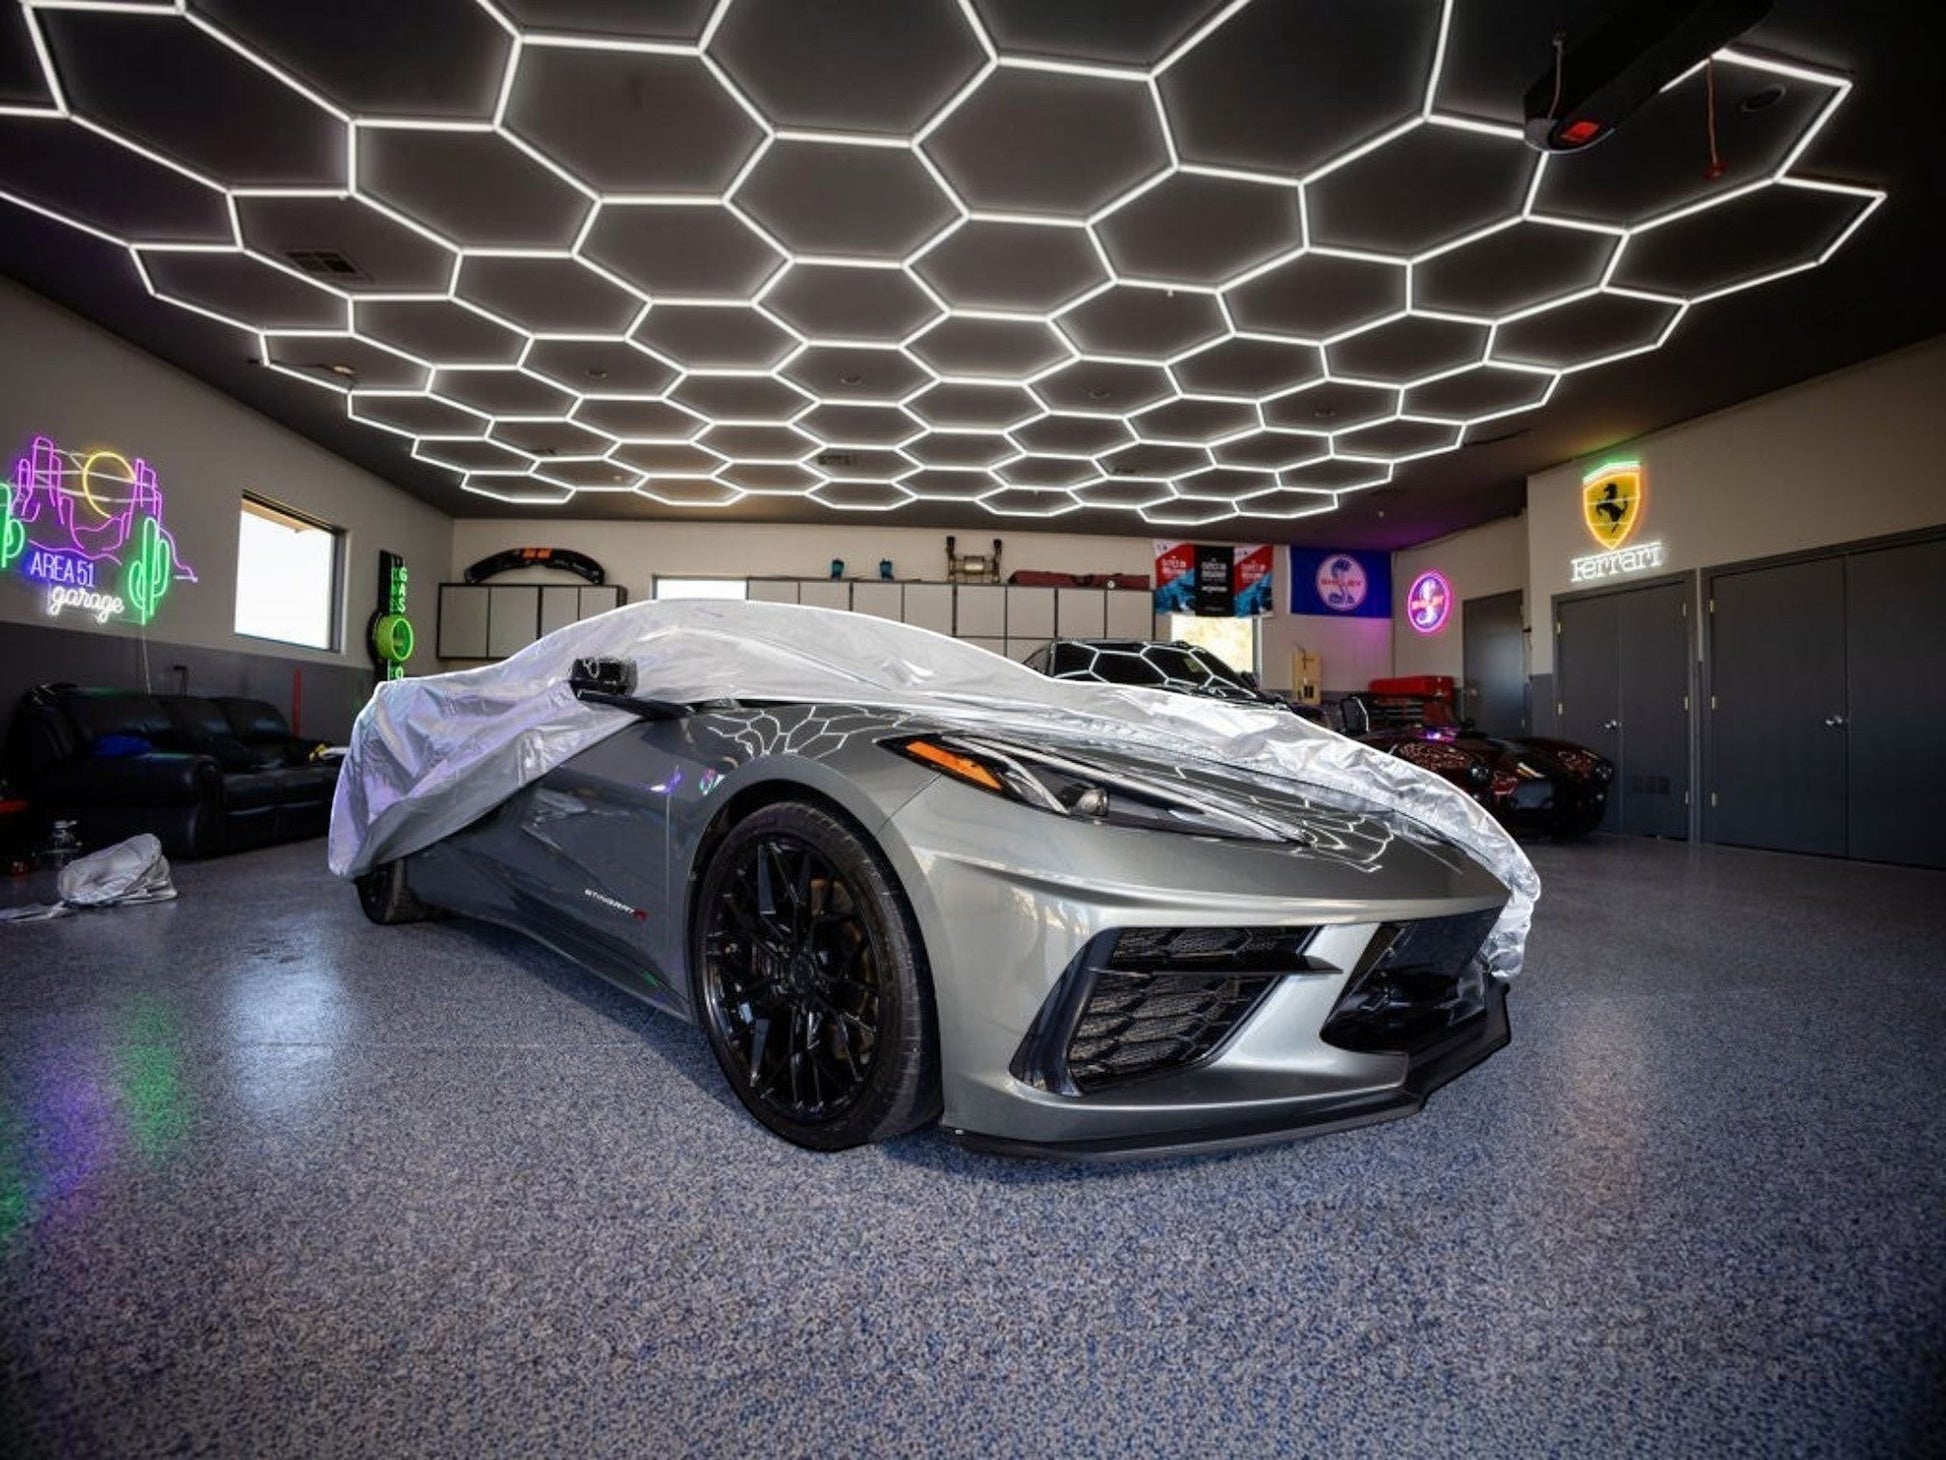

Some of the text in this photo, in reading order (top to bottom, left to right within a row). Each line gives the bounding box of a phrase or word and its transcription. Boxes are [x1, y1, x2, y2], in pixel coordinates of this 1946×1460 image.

[30, 551, 95, 587] AREA 51
[1570, 541, 1662, 582] Ferrari
[47, 586, 125, 624] garage
